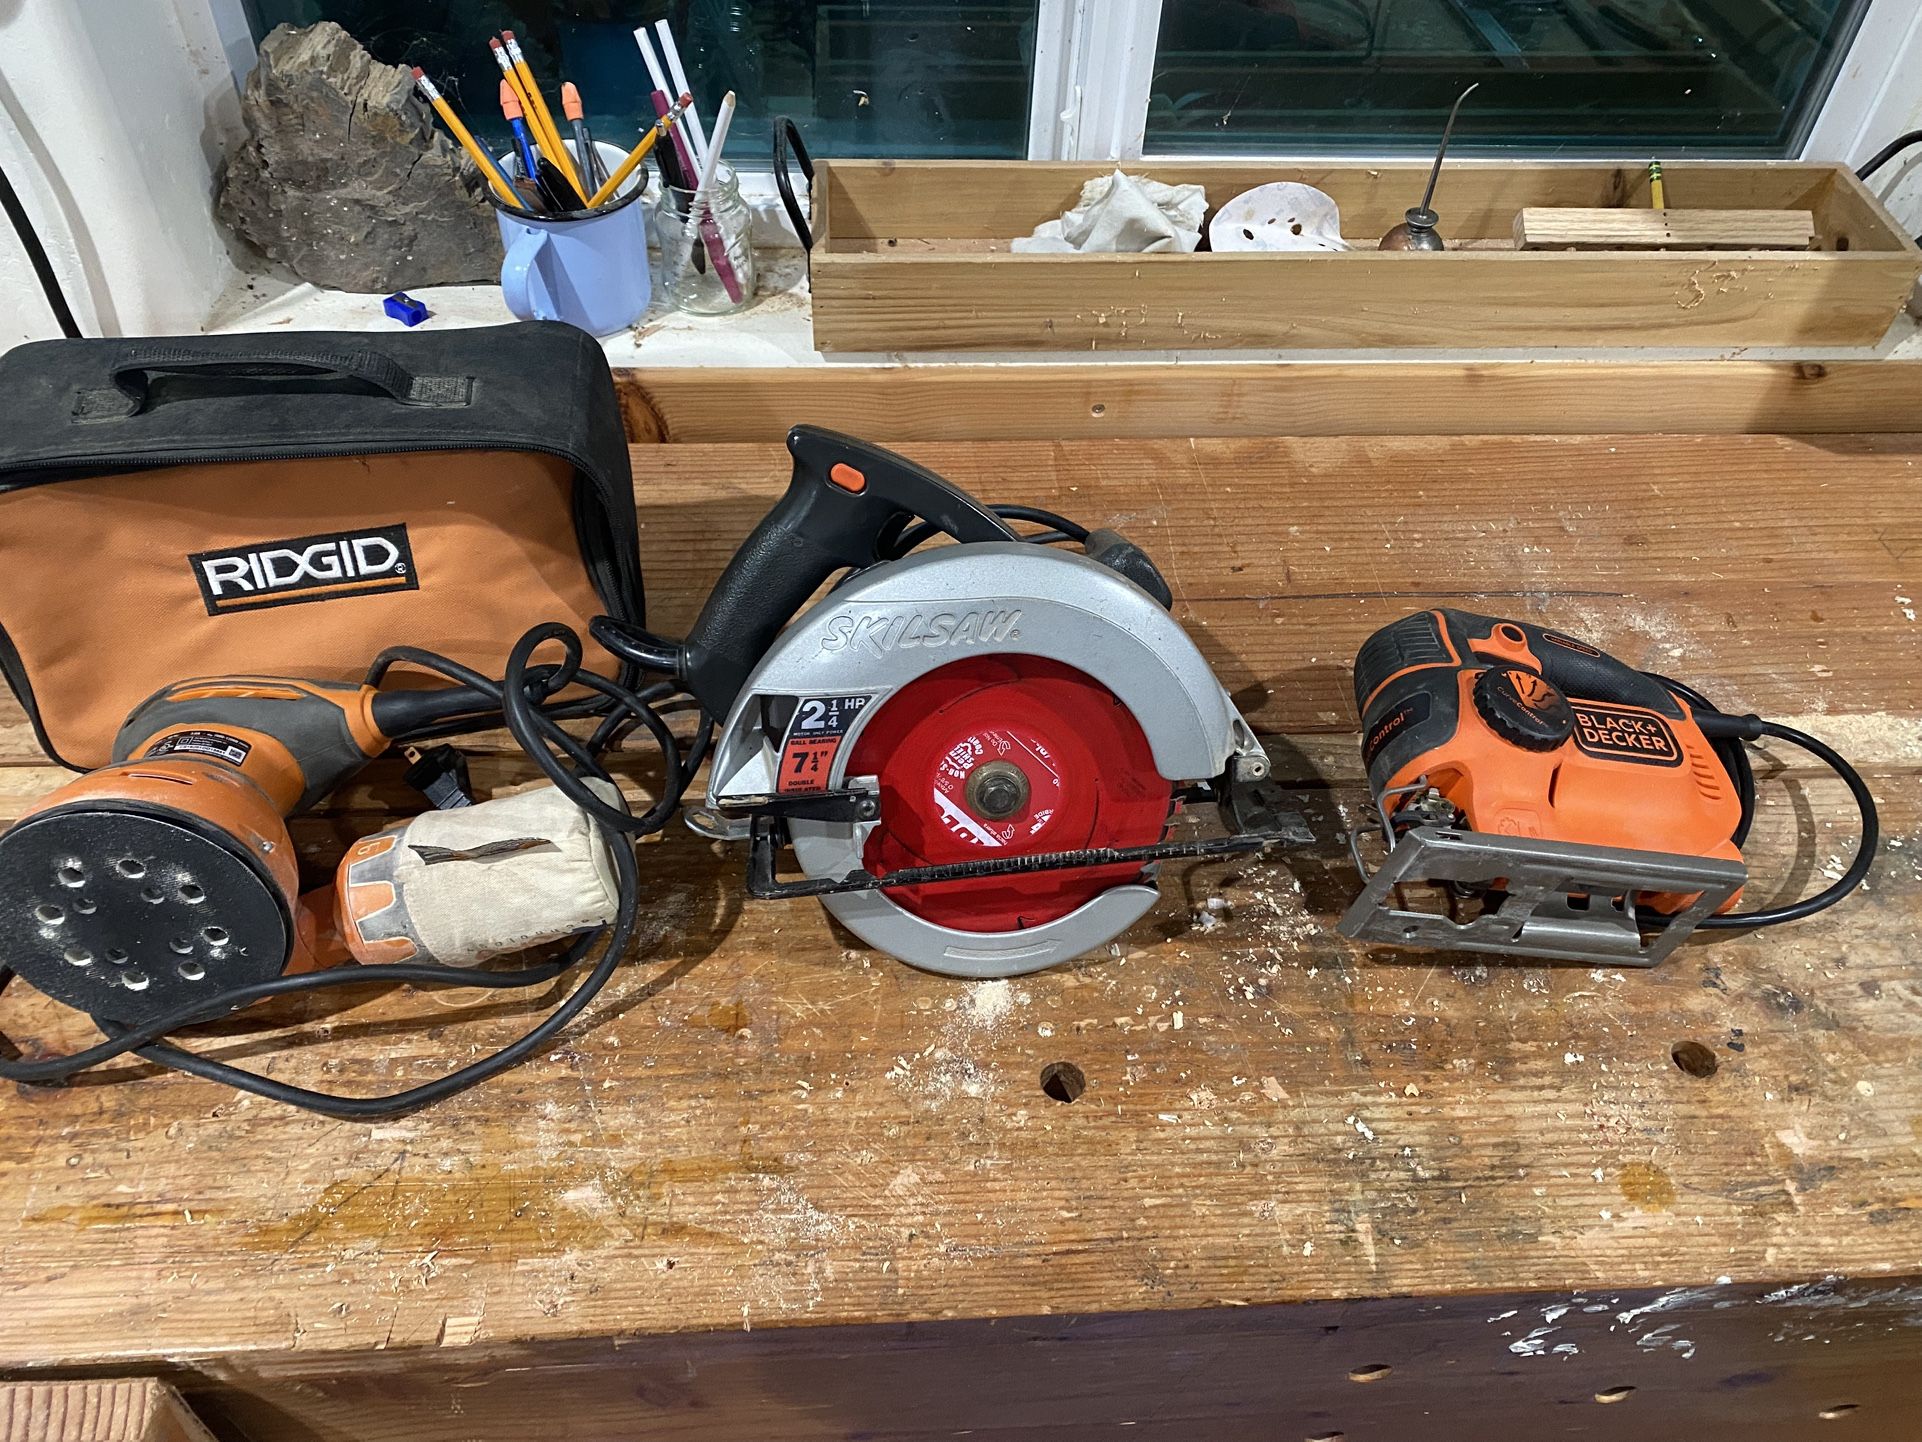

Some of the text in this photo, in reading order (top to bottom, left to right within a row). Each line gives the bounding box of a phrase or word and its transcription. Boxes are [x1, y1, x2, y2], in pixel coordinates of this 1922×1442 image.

[844, 697, 866, 710] HP
[1583, 727, 1669, 752] DECKER
[953, 745, 975, 765] SHIEL
[940, 761, 966, 779] Non-S
